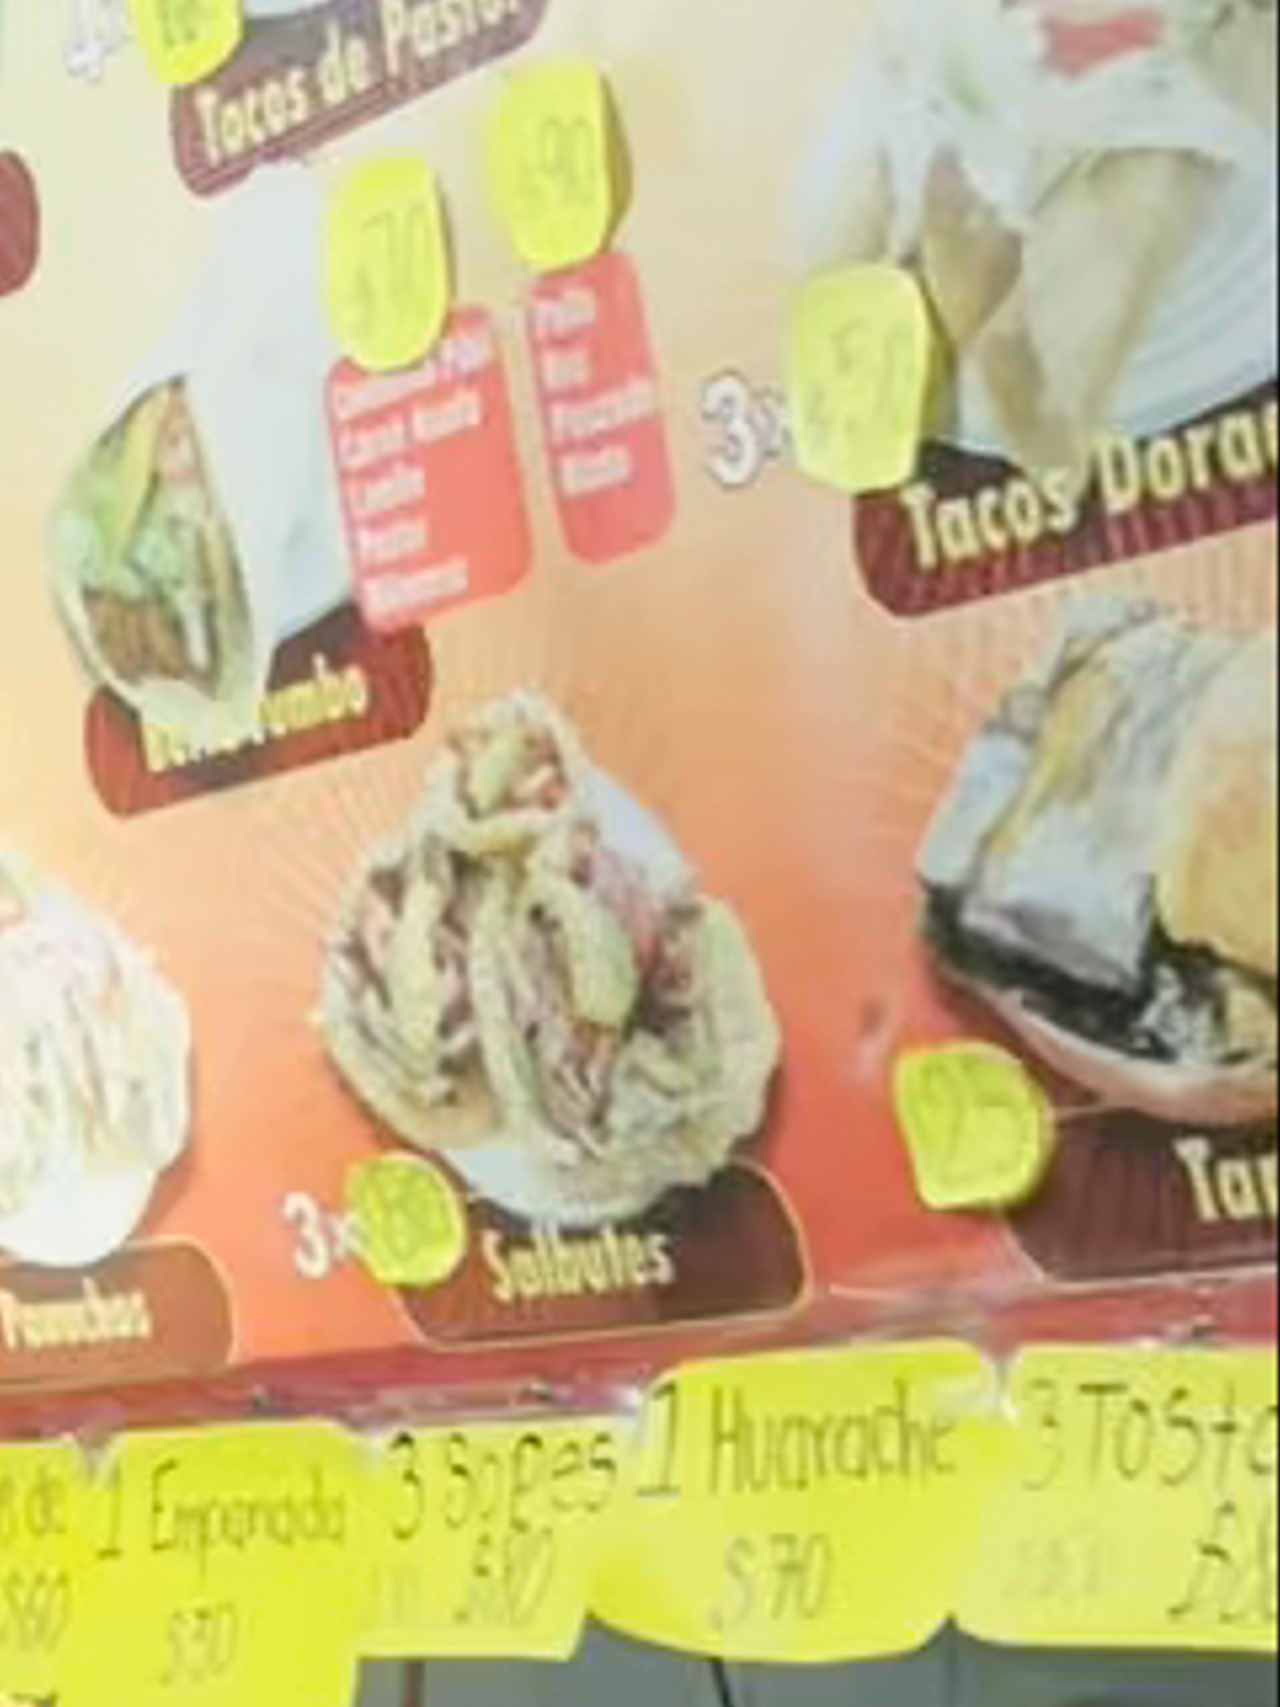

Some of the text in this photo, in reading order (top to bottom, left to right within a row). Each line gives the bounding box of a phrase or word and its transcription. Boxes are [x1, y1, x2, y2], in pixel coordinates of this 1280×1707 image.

[194, 66, 309, 165] Tacos
[316, 17, 372, 99] de
[900, 466, 1080, 569] Tacos
[480, 1218, 676, 1301] Salbutes
[388, 1430, 428, 1543] 3
[708, 1375, 960, 1495] Huarache
